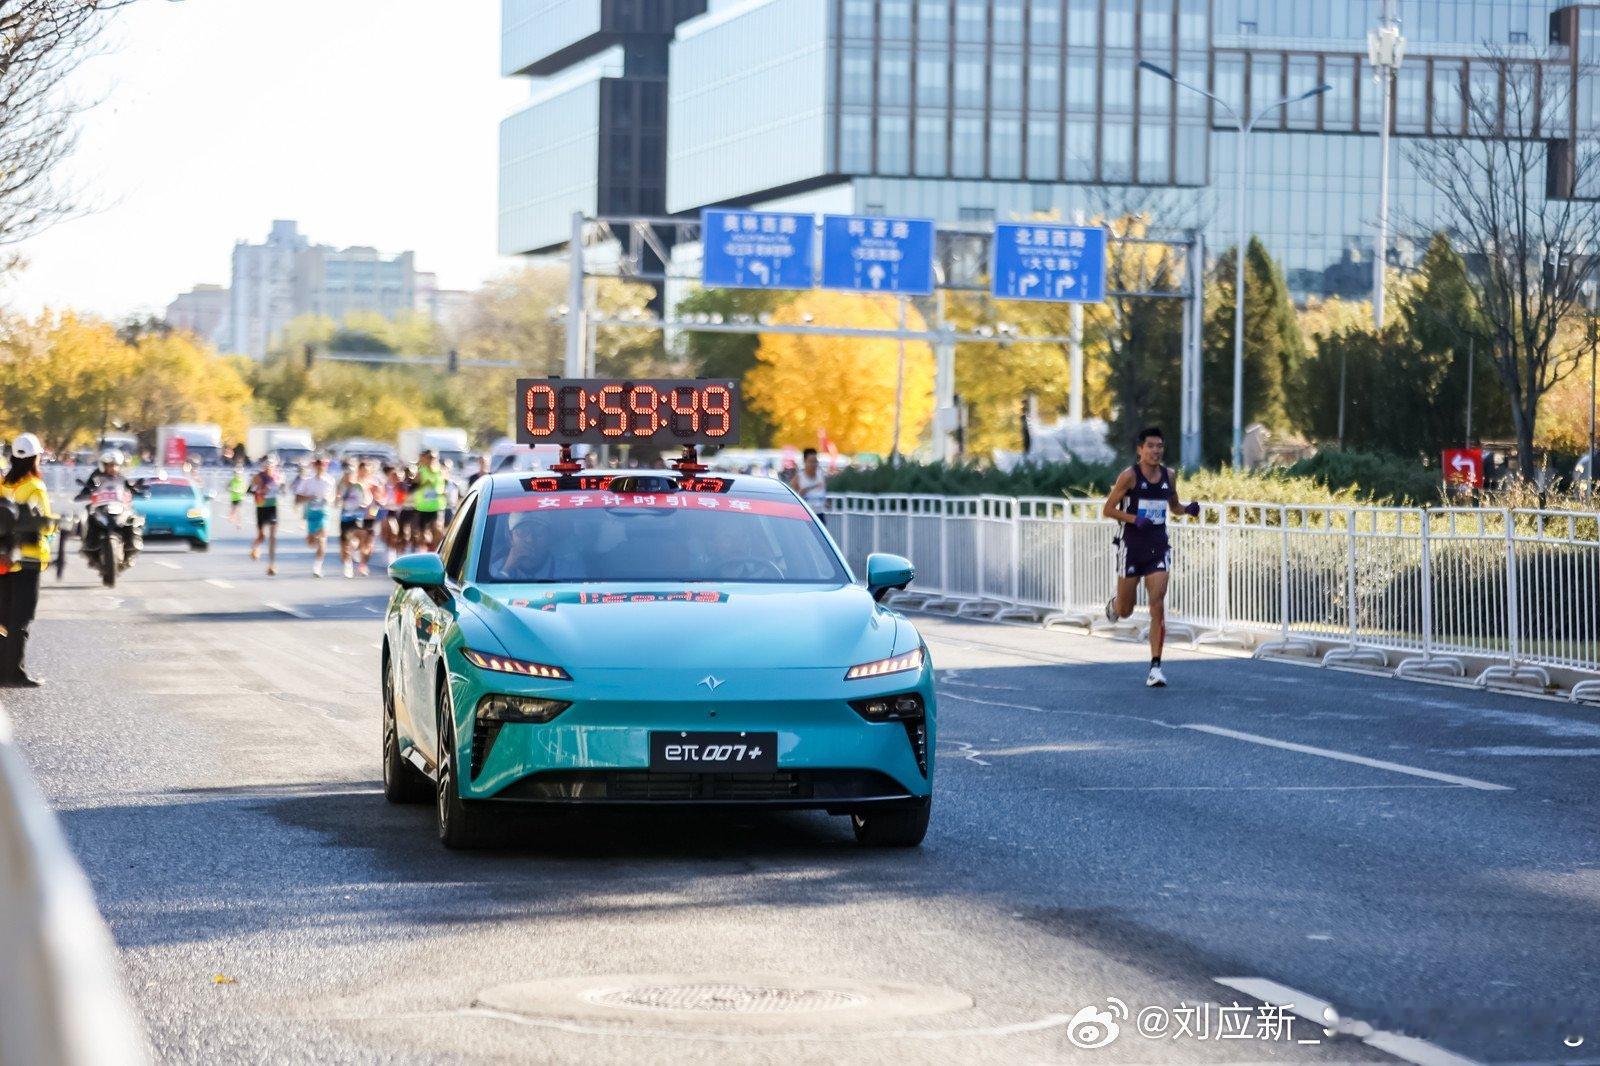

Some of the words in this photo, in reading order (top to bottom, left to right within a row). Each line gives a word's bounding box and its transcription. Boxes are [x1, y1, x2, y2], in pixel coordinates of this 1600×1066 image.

[526, 385, 730, 436] 01:59:49
[537, 495, 752, 511] 女子计时引导车
